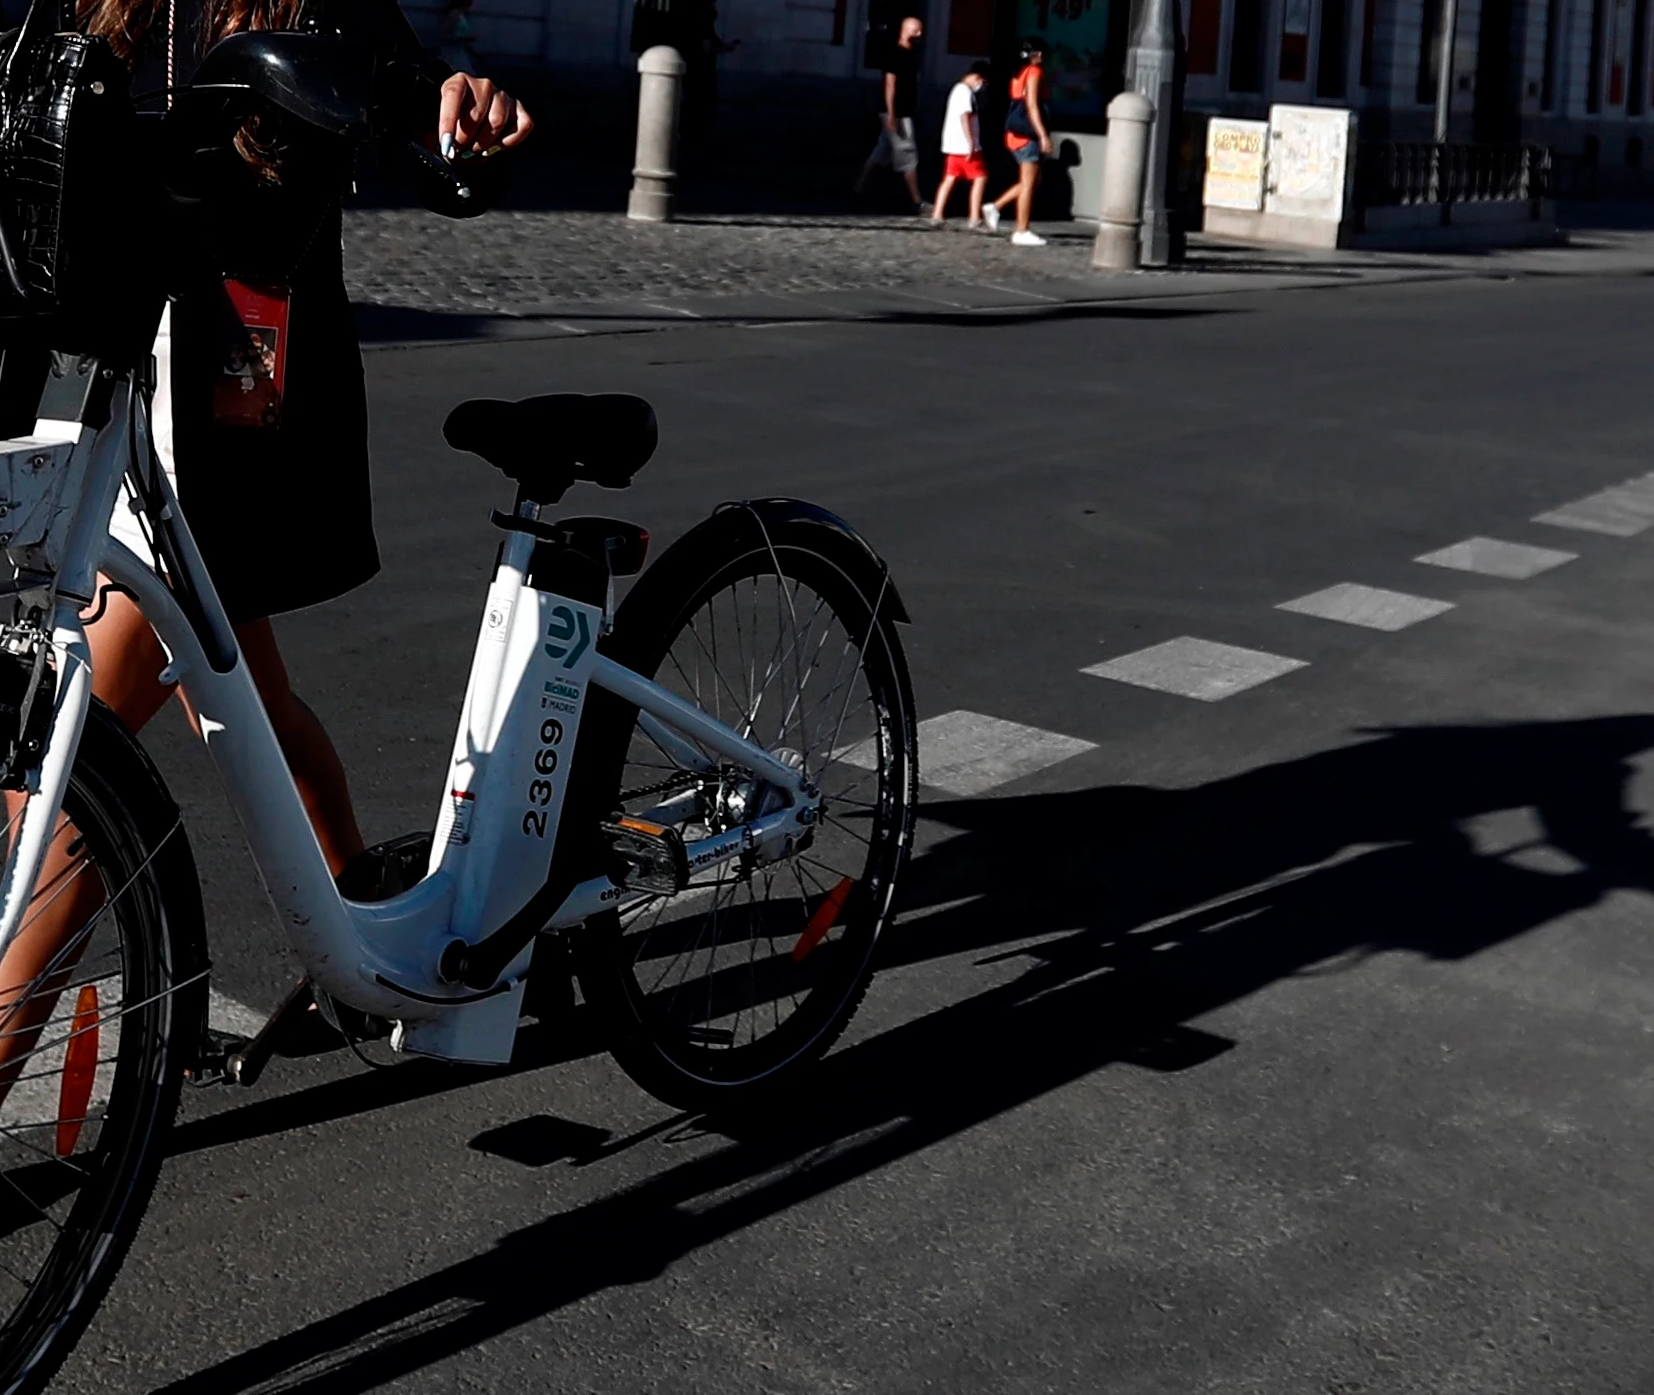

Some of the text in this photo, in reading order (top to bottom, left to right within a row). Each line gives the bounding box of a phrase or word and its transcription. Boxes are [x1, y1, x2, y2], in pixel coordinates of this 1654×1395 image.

[1214, 132, 1261, 144] COMPRO
[549, 699, 577, 715] MADRID
[522, 718, 563, 839] 2369
